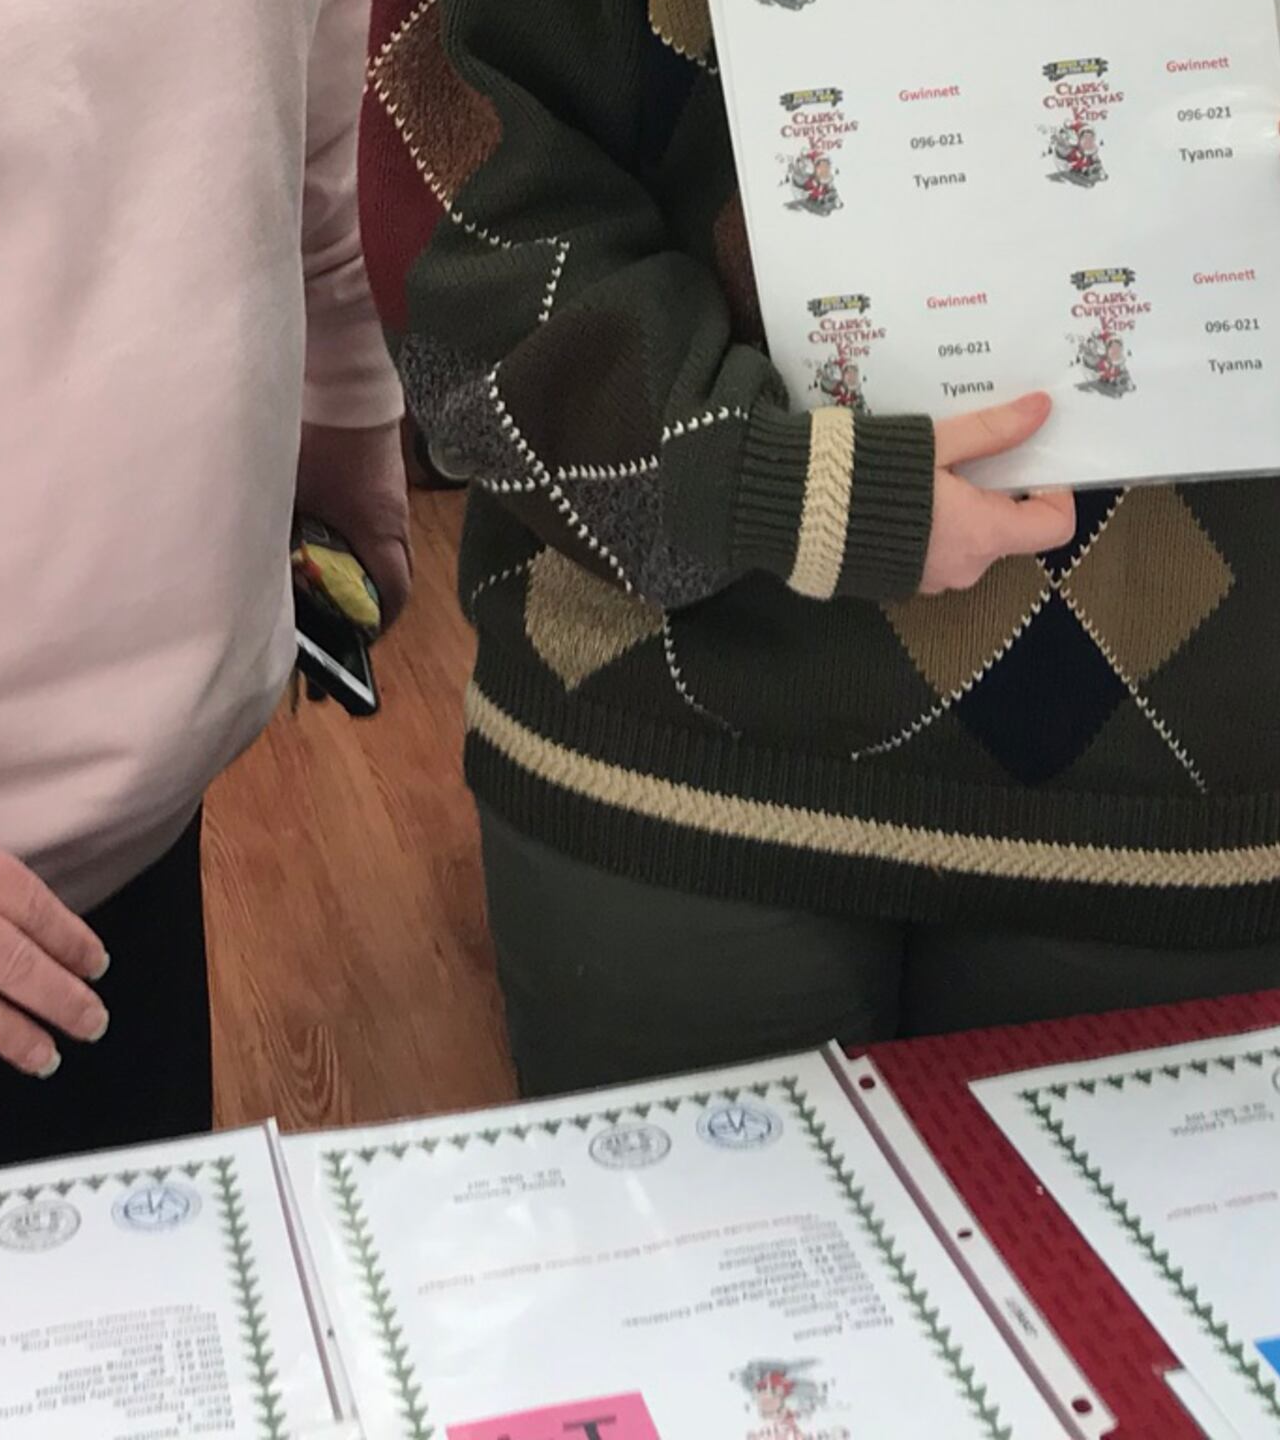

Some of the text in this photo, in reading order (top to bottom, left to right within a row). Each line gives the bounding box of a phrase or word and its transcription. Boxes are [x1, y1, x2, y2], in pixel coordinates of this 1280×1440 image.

[1166, 57, 1230, 73] Gwinnett
[899, 85, 960, 102] Gwinnett
[1177, 106, 1232, 122] 096-021
[910, 133, 964, 150] 096-021
[1179, 146, 1234, 163] Tyanna
[913, 172, 967, 190] Tyanna
[1193, 269, 1256, 285] Gwinnett
[926, 292, 988, 309] Gwinnett
[1205, 318, 1260, 333] 096-021
[938, 341, 991, 358] 096-021
[1208, 358, 1263, 374] Tyanna
[941, 380, 994, 397] Tyanna
